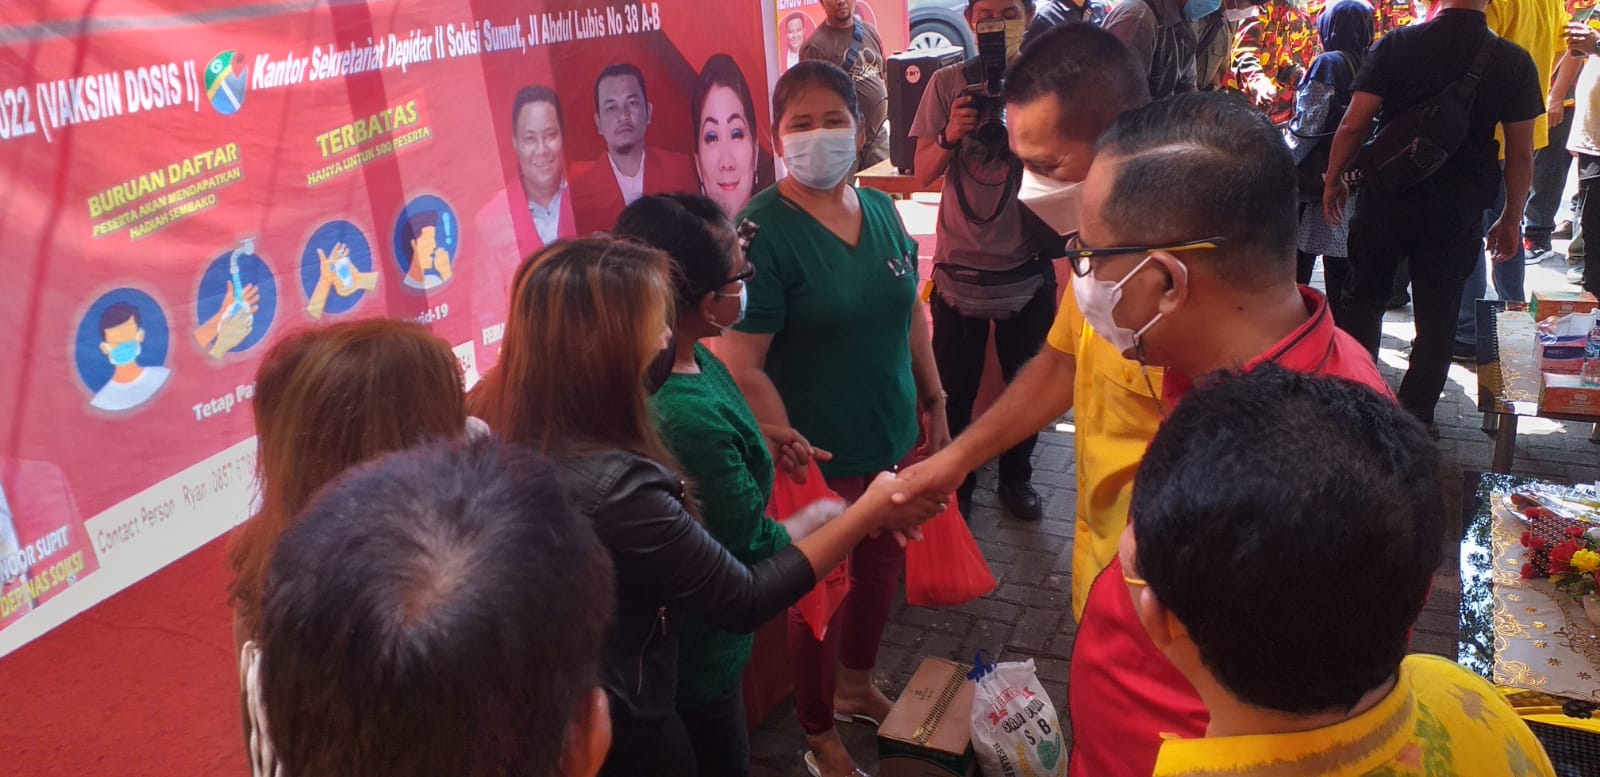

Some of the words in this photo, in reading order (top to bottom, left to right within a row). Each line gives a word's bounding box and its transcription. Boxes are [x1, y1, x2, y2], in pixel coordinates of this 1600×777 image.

[252, 52, 308, 90] Kantor
[309, 36, 384, 81] Sekretariat
[386, 30, 432, 73] Depidar
[446, 20, 482, 57] Soksi
[483, 17, 525, 54] Sumut,
[542, 11, 573, 45] Abdul
[574, 8, 605, 40] Lubis
[607, 6, 622, 35] No
[625, 4, 639, 33] 38
[642, 2, 660, 31] A-B
[36, 72, 122, 143] (VAKSIN
[125, 62, 182, 114] DOSIS
[316, 100, 417, 157] TERBATAS
[88, 169, 166, 218] BURUAN
[168, 143, 238, 184] DAFTAR
[307, 162, 343, 185] HANYA
[343, 148, 375, 169] UNTUK
[375, 141, 392, 156] 500
[392, 127, 431, 149] PESERTA
[93, 209, 139, 237] PESERTA
[139, 196, 167, 216] AKAN
[168, 168, 241, 204] MENDAPATKAN
[130, 214, 169, 239] HADIAH
[169, 194, 216, 220] SEMBAKO
[192, 393, 235, 421] Tetap
[97, 516, 140, 555] Contact
[141, 498, 176, 527] Person
[182, 482, 207, 511] Ryan
[211, 461, 233, 493] 0857
[36, 525, 70, 560] SUPIT
[50, 551, 85, 586] SOKSI
[1037, 718, 1051, 735] B
